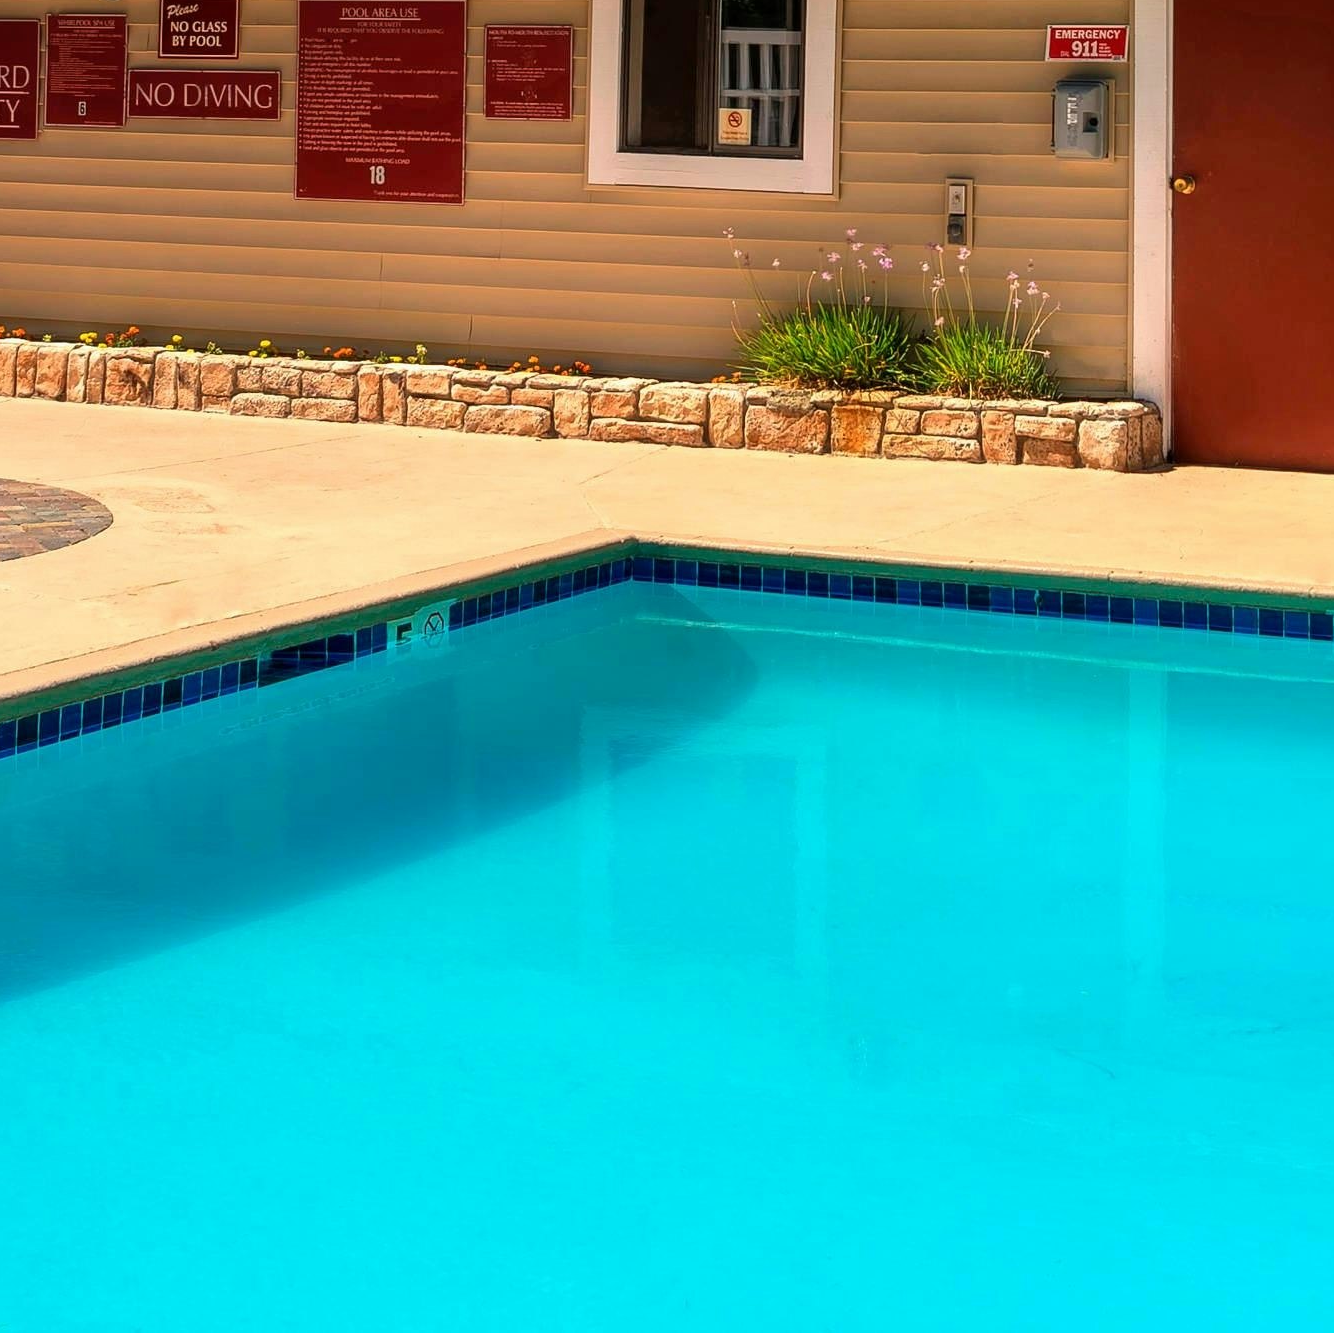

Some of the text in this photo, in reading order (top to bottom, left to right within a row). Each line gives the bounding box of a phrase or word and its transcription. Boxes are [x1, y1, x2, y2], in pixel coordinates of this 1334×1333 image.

[166, 3, 199, 19] Please
[342, 7, 419, 18] POOL AREA USE
[170, 21, 228, 33] NO GLASS
[1055, 29, 1121, 40] EMERGENCY
[172, 35, 222, 47] BY POOL
[1071, 40, 1098, 57] 911
[135, 82, 273, 109] NO DIVING
[79, 101, 86, 116] 6
[369, 165, 385, 185] 18
